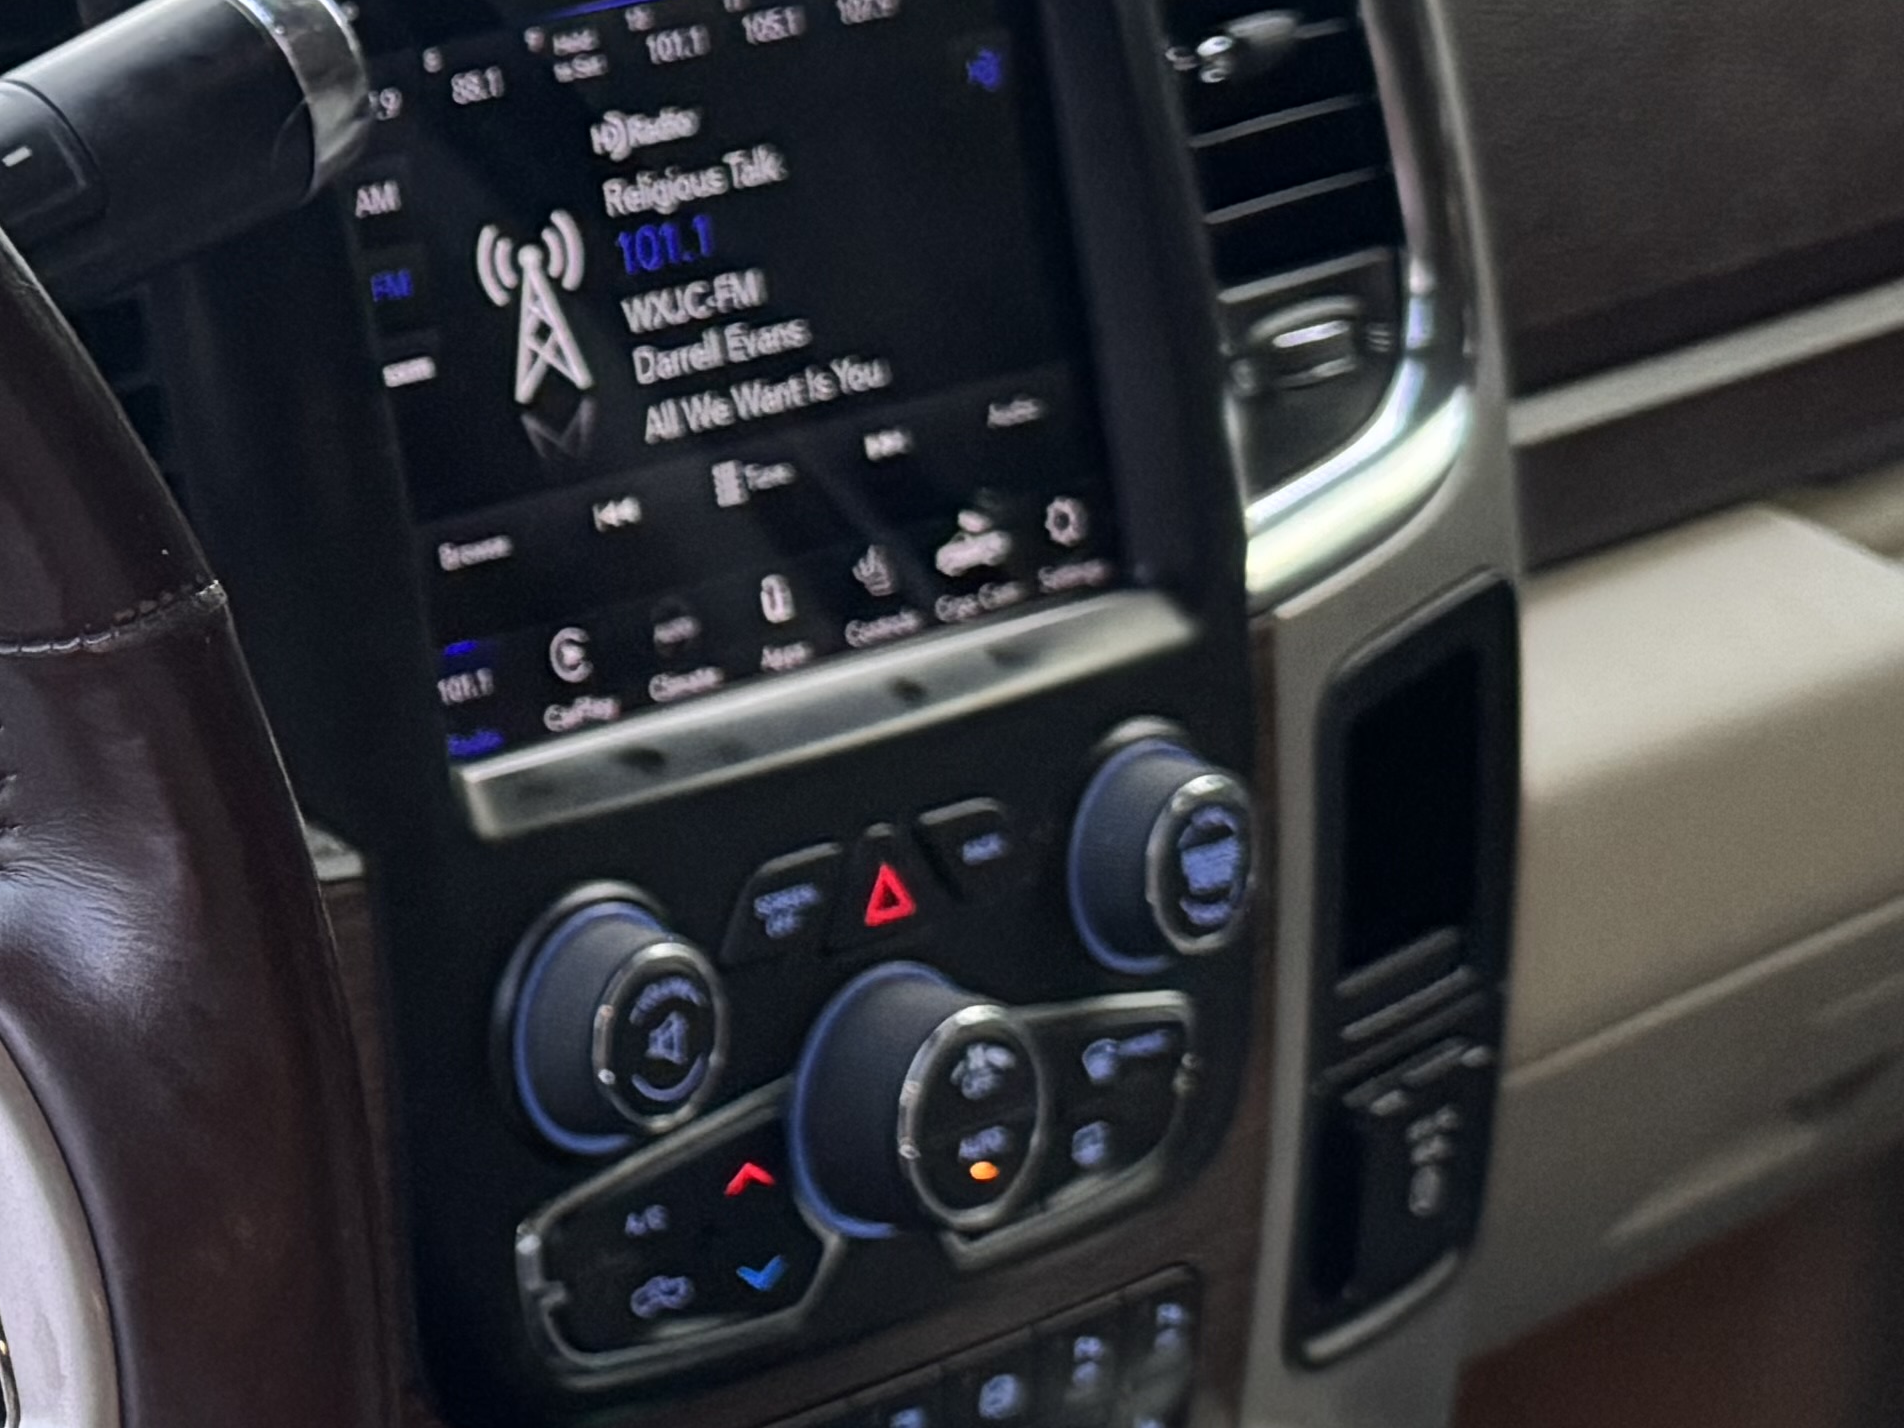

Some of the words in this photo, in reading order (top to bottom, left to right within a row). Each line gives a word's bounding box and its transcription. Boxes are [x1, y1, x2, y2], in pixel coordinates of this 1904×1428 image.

[646, 24, 711, 64] 101.1
[355, 180, 401, 218] AM
[601, 163, 727, 217] Religious
[722, 143, 789, 189] Talk
[615, 213, 715, 275] 101.1
[370, 269, 414, 302] FM
[631, 329, 721, 386] Darrell
[723, 317, 814, 363] Evans
[645, 400, 680, 444] All
[680, 388, 735, 433] We
[731, 375, 805, 421] Want
[830, 354, 891, 396] You
